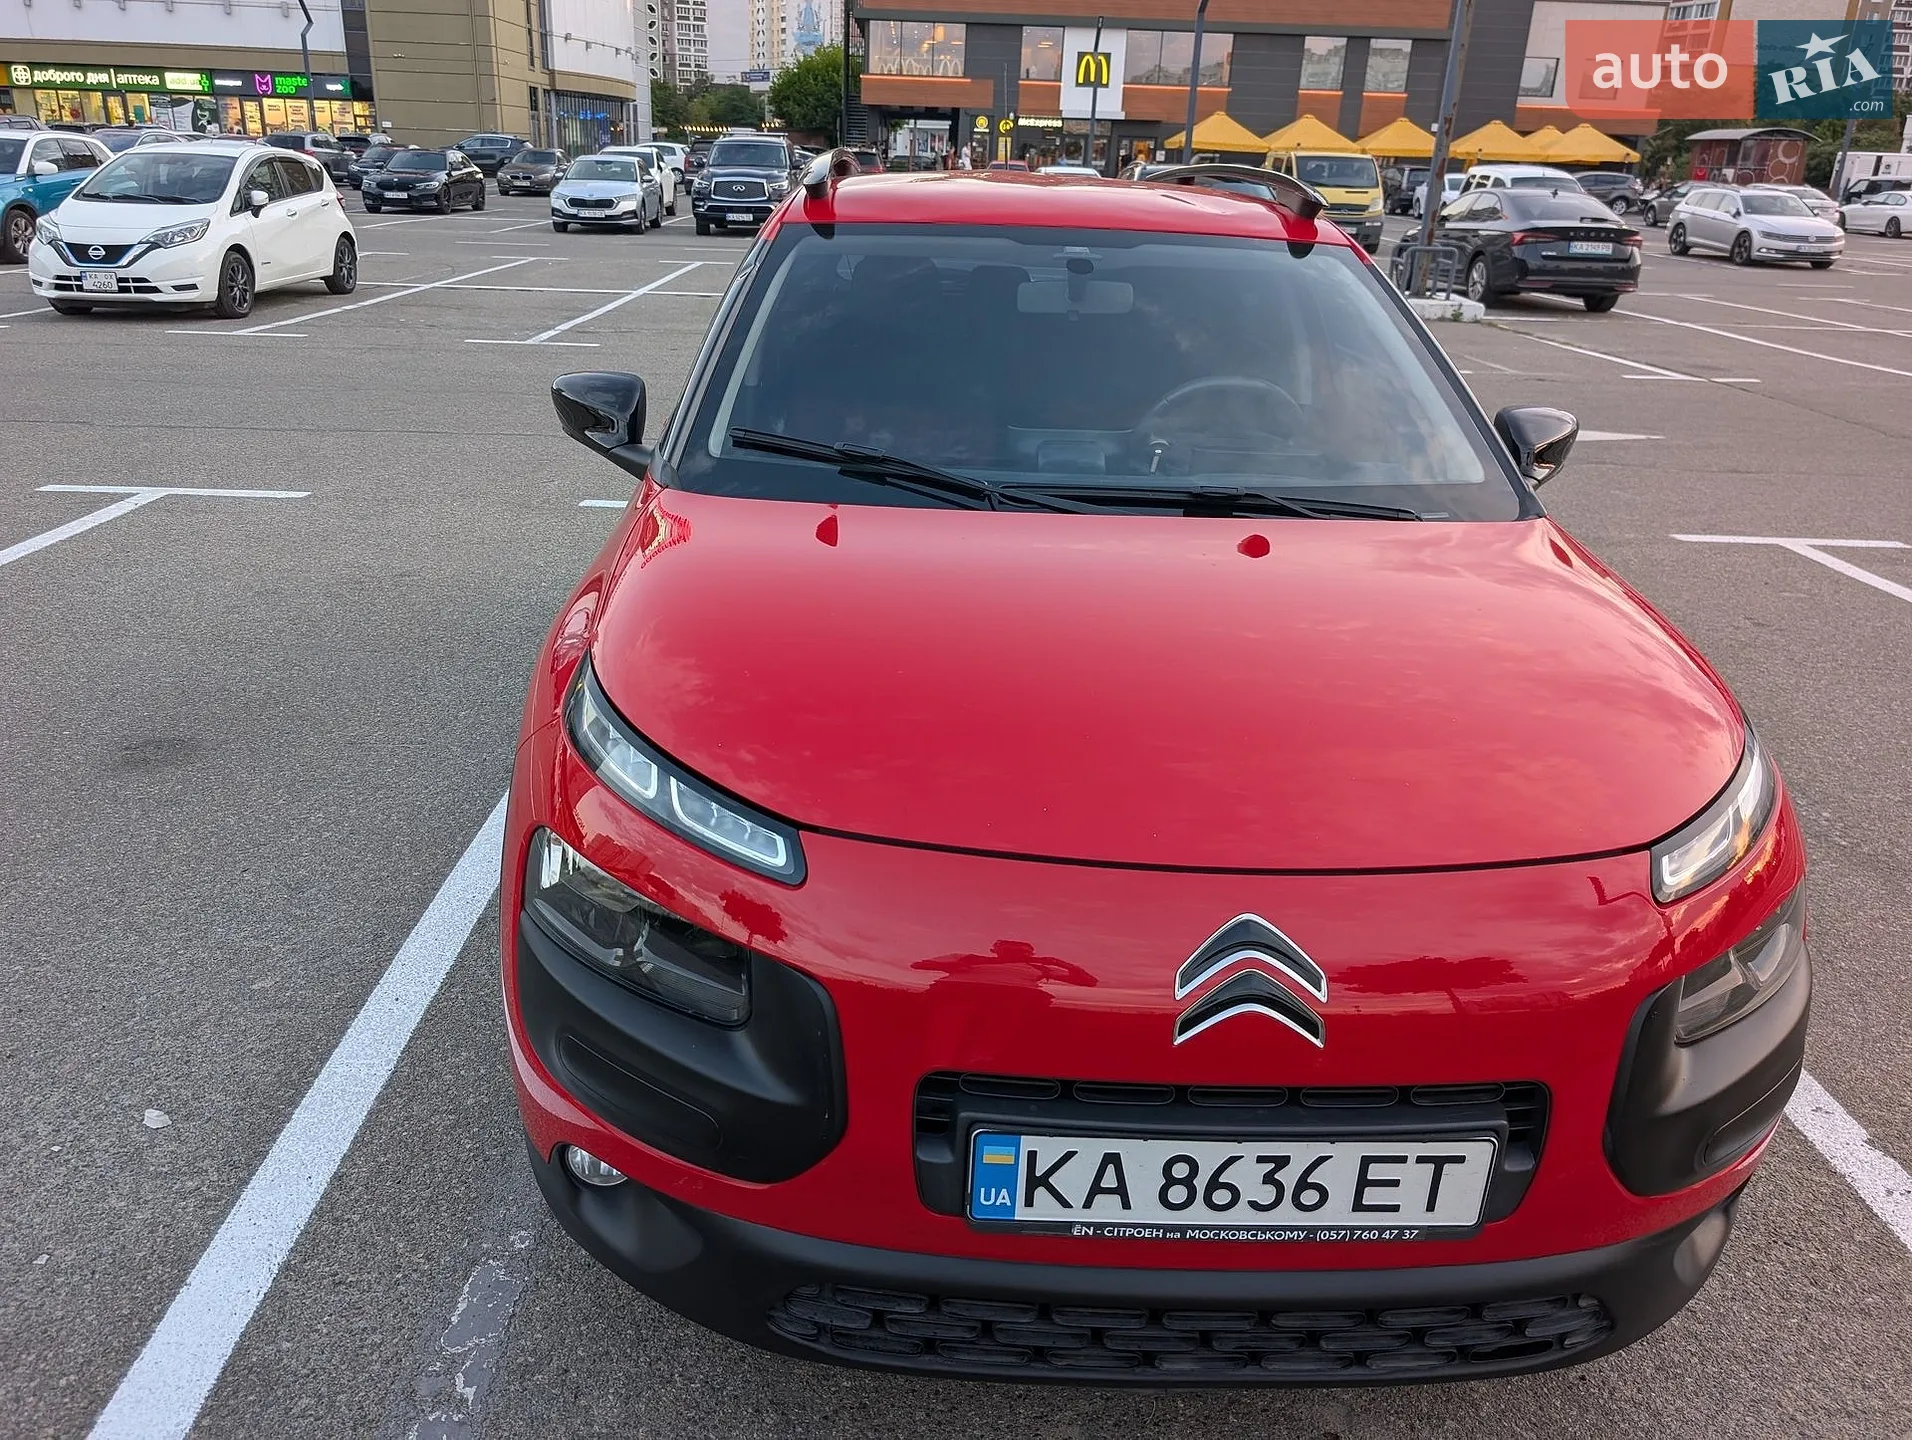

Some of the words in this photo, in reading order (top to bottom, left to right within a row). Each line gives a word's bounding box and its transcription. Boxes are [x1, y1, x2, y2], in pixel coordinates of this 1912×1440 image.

[33, 70, 84, 85] доброго
[86, 71, 110, 86] дня
[117, 73, 160, 86] аптека
[275, 76, 309, 87] maste
[276, 85, 296, 94] zoo
[92, 281, 113, 289] 4260
[1024, 1149, 1132, 1210] KA
[1158, 1154, 1334, 1212] 8636
[1352, 1155, 1466, 1213] ET
[980, 1187, 1012, 1206] UA
[1104, 1227, 1163, 1239] СІТРОЕН
[1166, 1231, 1181, 1239] на
[1186, 1229, 1308, 1241] МОСКОВСЬКОМУ
[1316, 1229, 1351, 1242] (057)
[1353, 1230, 1379, 1241] 760
[1382, 1230, 1399, 1240] 47
[1402, 1229, 1419, 1240] 37
